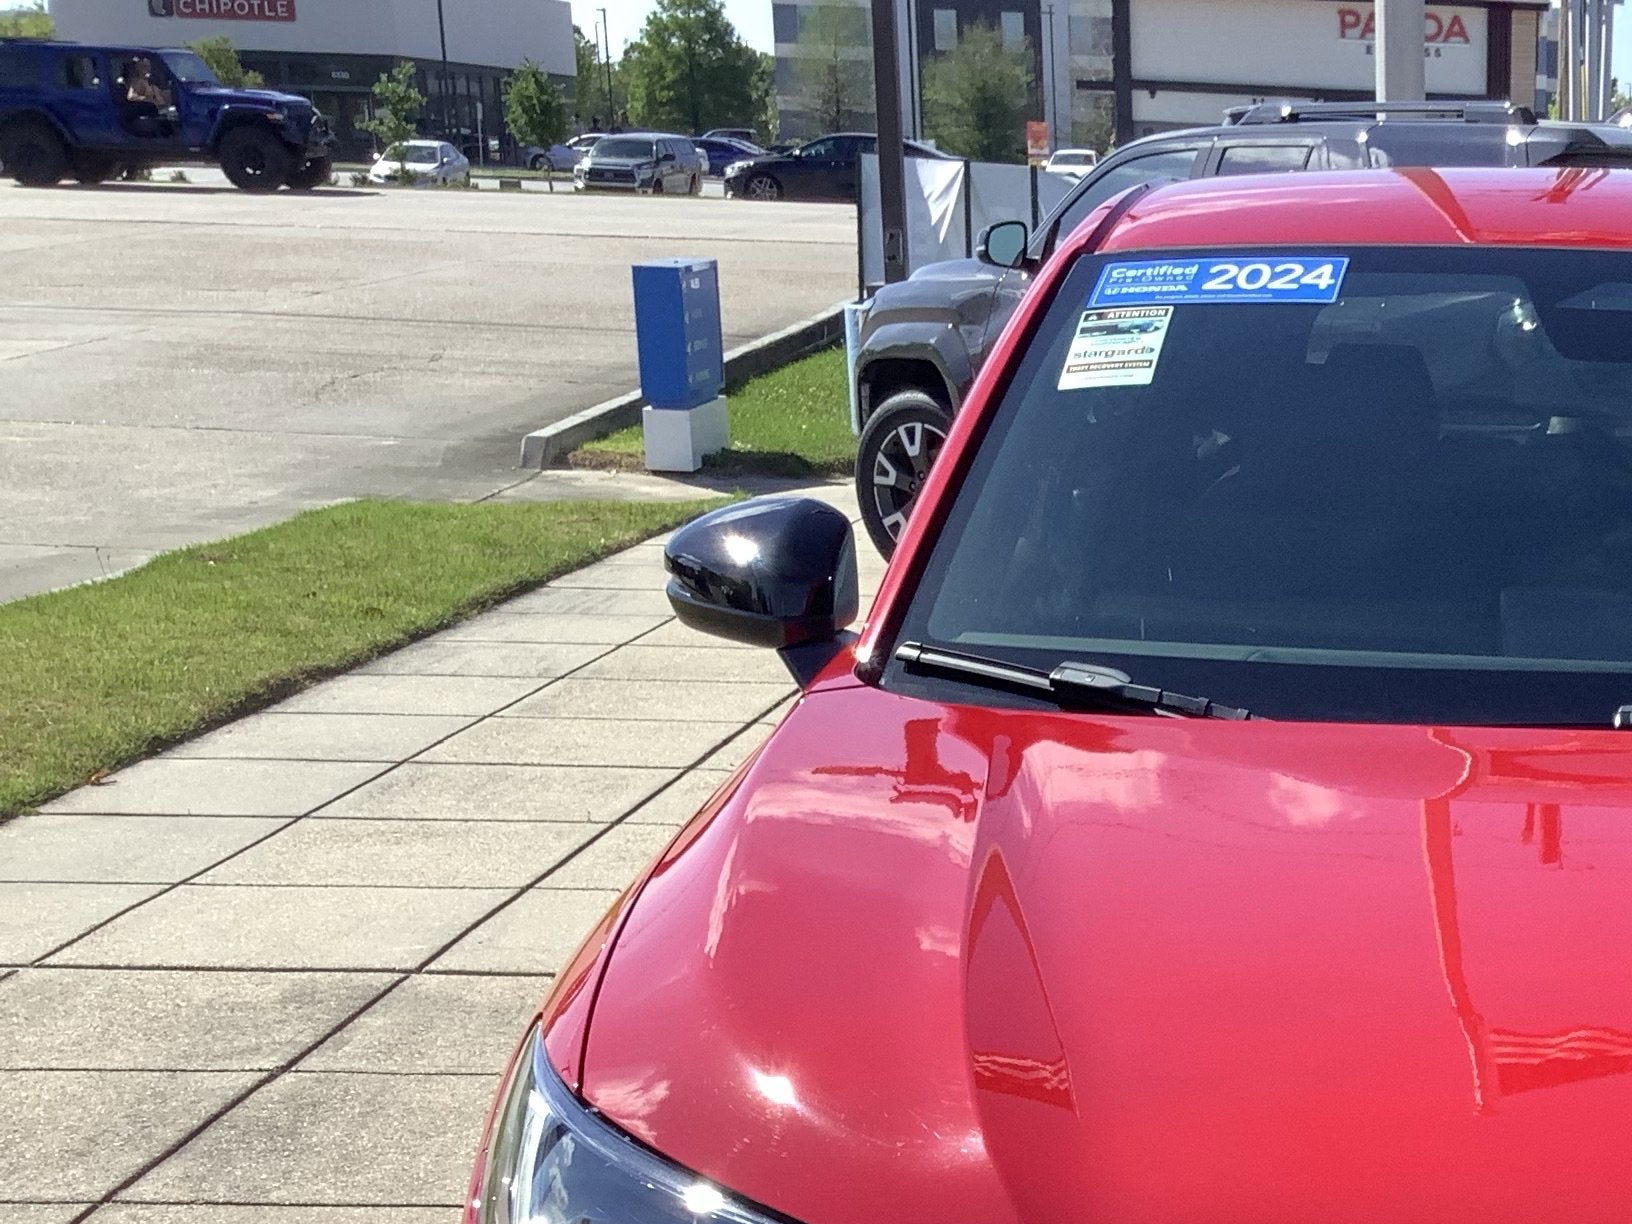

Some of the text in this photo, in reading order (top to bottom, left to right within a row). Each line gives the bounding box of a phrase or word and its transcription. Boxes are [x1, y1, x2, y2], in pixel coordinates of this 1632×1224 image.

[179, 0, 289, 16] CHIPOTLE
[1337, 8, 1471, 44] PADA
[1111, 263, 1336, 290] Certified 2024
[1120, 285, 1188, 294] HONDA
[1107, 308, 1166, 319] ATTENTION
